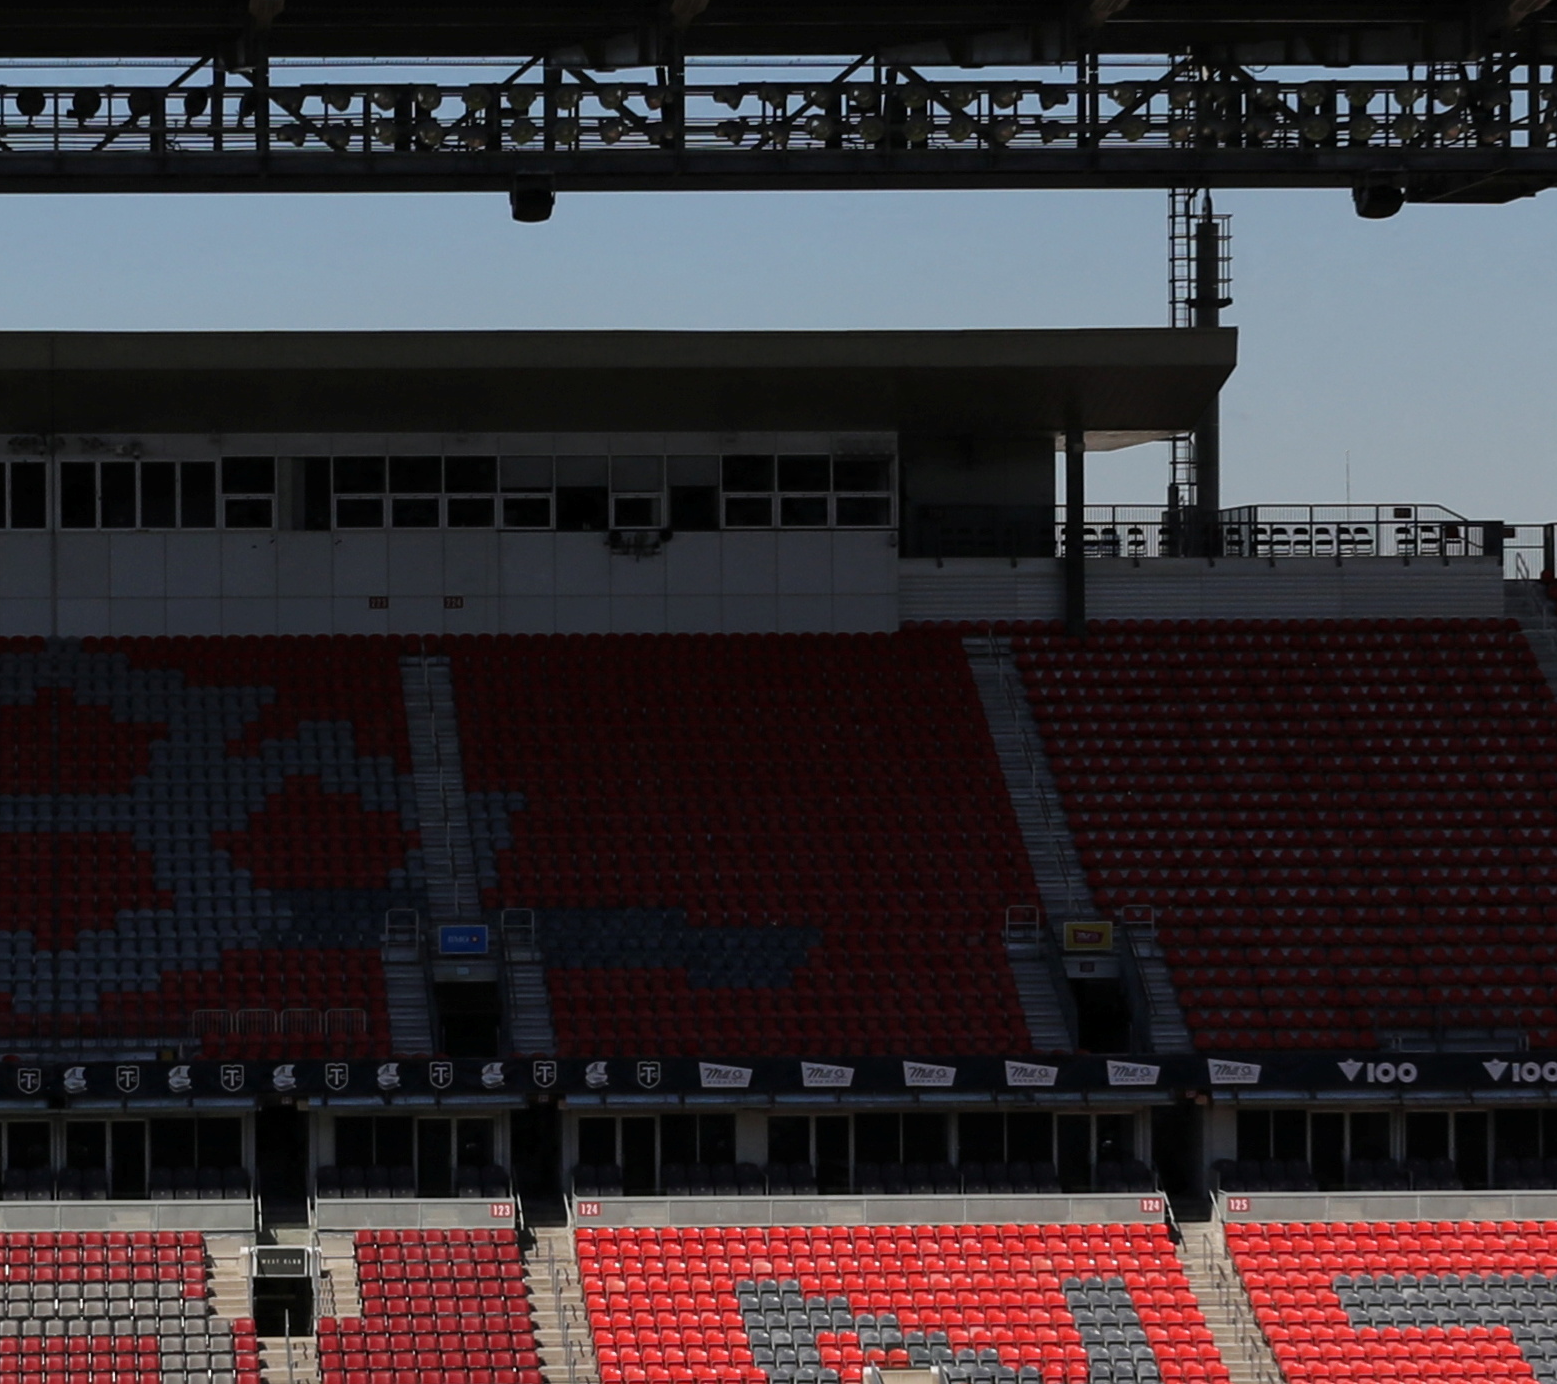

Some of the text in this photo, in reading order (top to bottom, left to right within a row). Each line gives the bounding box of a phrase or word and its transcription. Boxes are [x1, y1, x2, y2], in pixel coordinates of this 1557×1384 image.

[1366, 1062, 1418, 1084] 100
[493, 1205, 511, 1216] 123
[581, 1203, 598, 1215] 124
[1143, 1199, 1160, 1211] 124
[1231, 1199, 1248, 1210] 125
